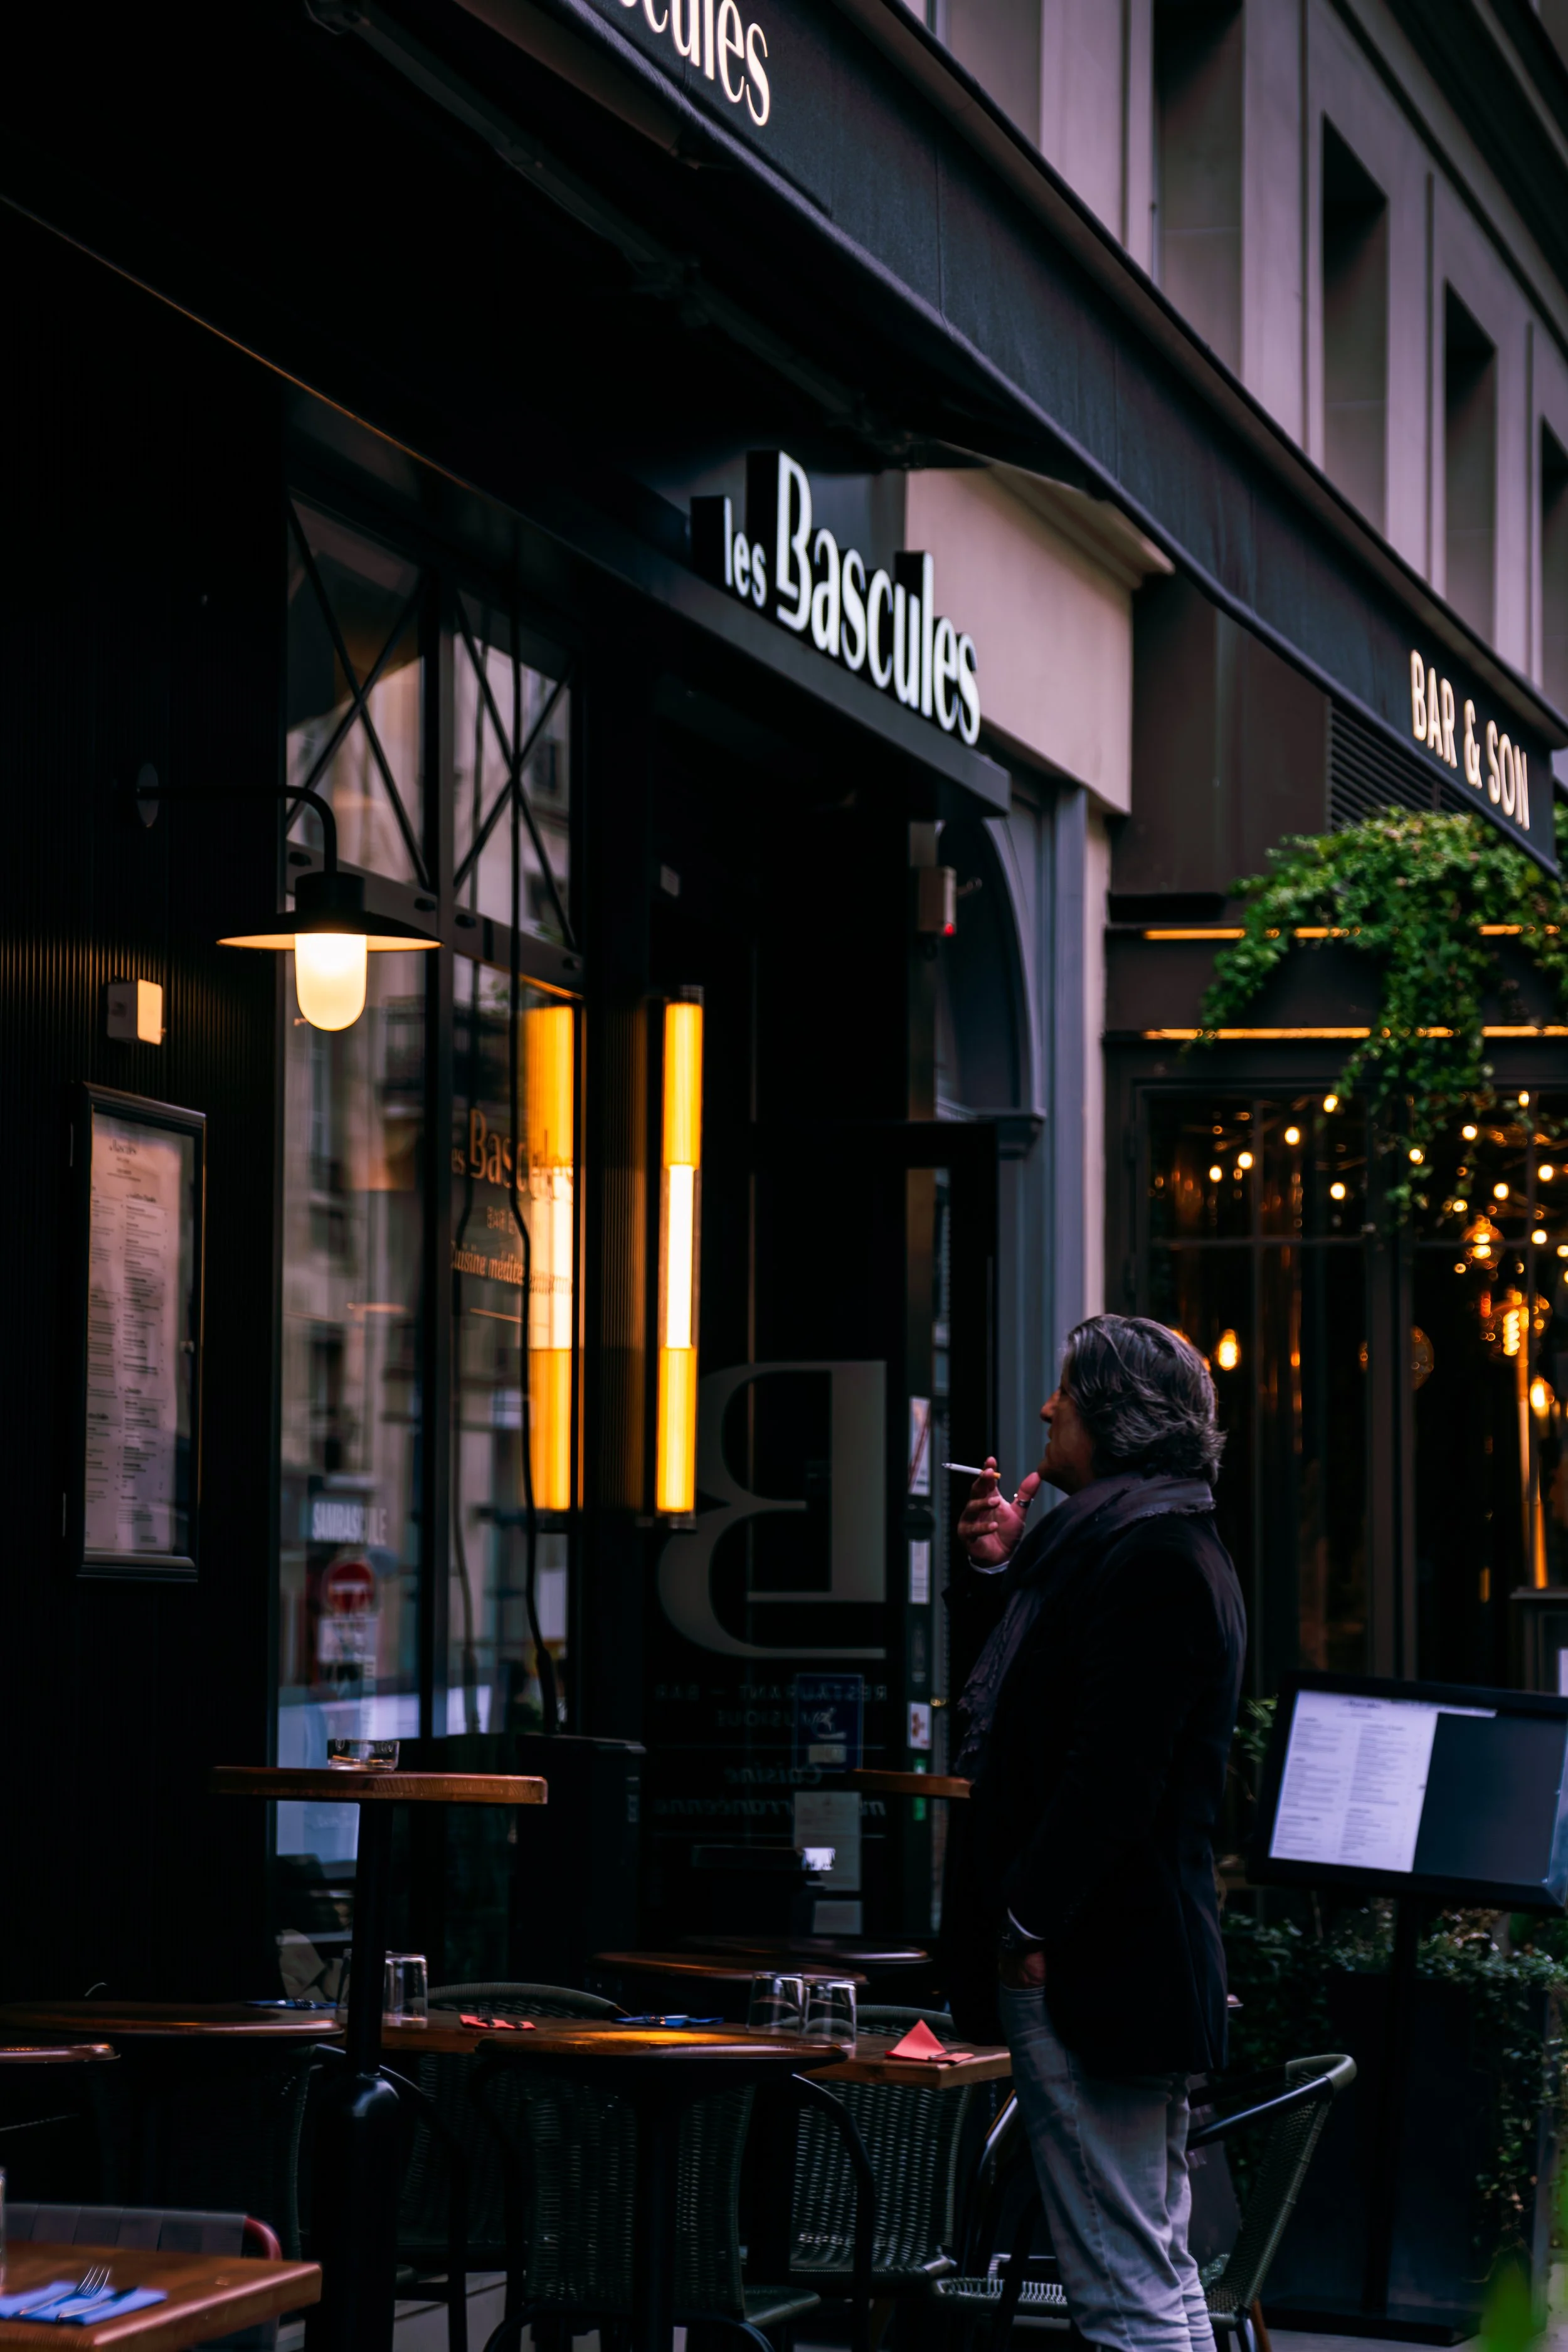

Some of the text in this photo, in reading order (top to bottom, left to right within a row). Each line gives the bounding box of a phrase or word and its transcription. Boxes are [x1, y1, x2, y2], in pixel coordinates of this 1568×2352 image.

[723, 449, 980, 746] les Bascules
[1411, 649, 1530, 831] BAR & SON
